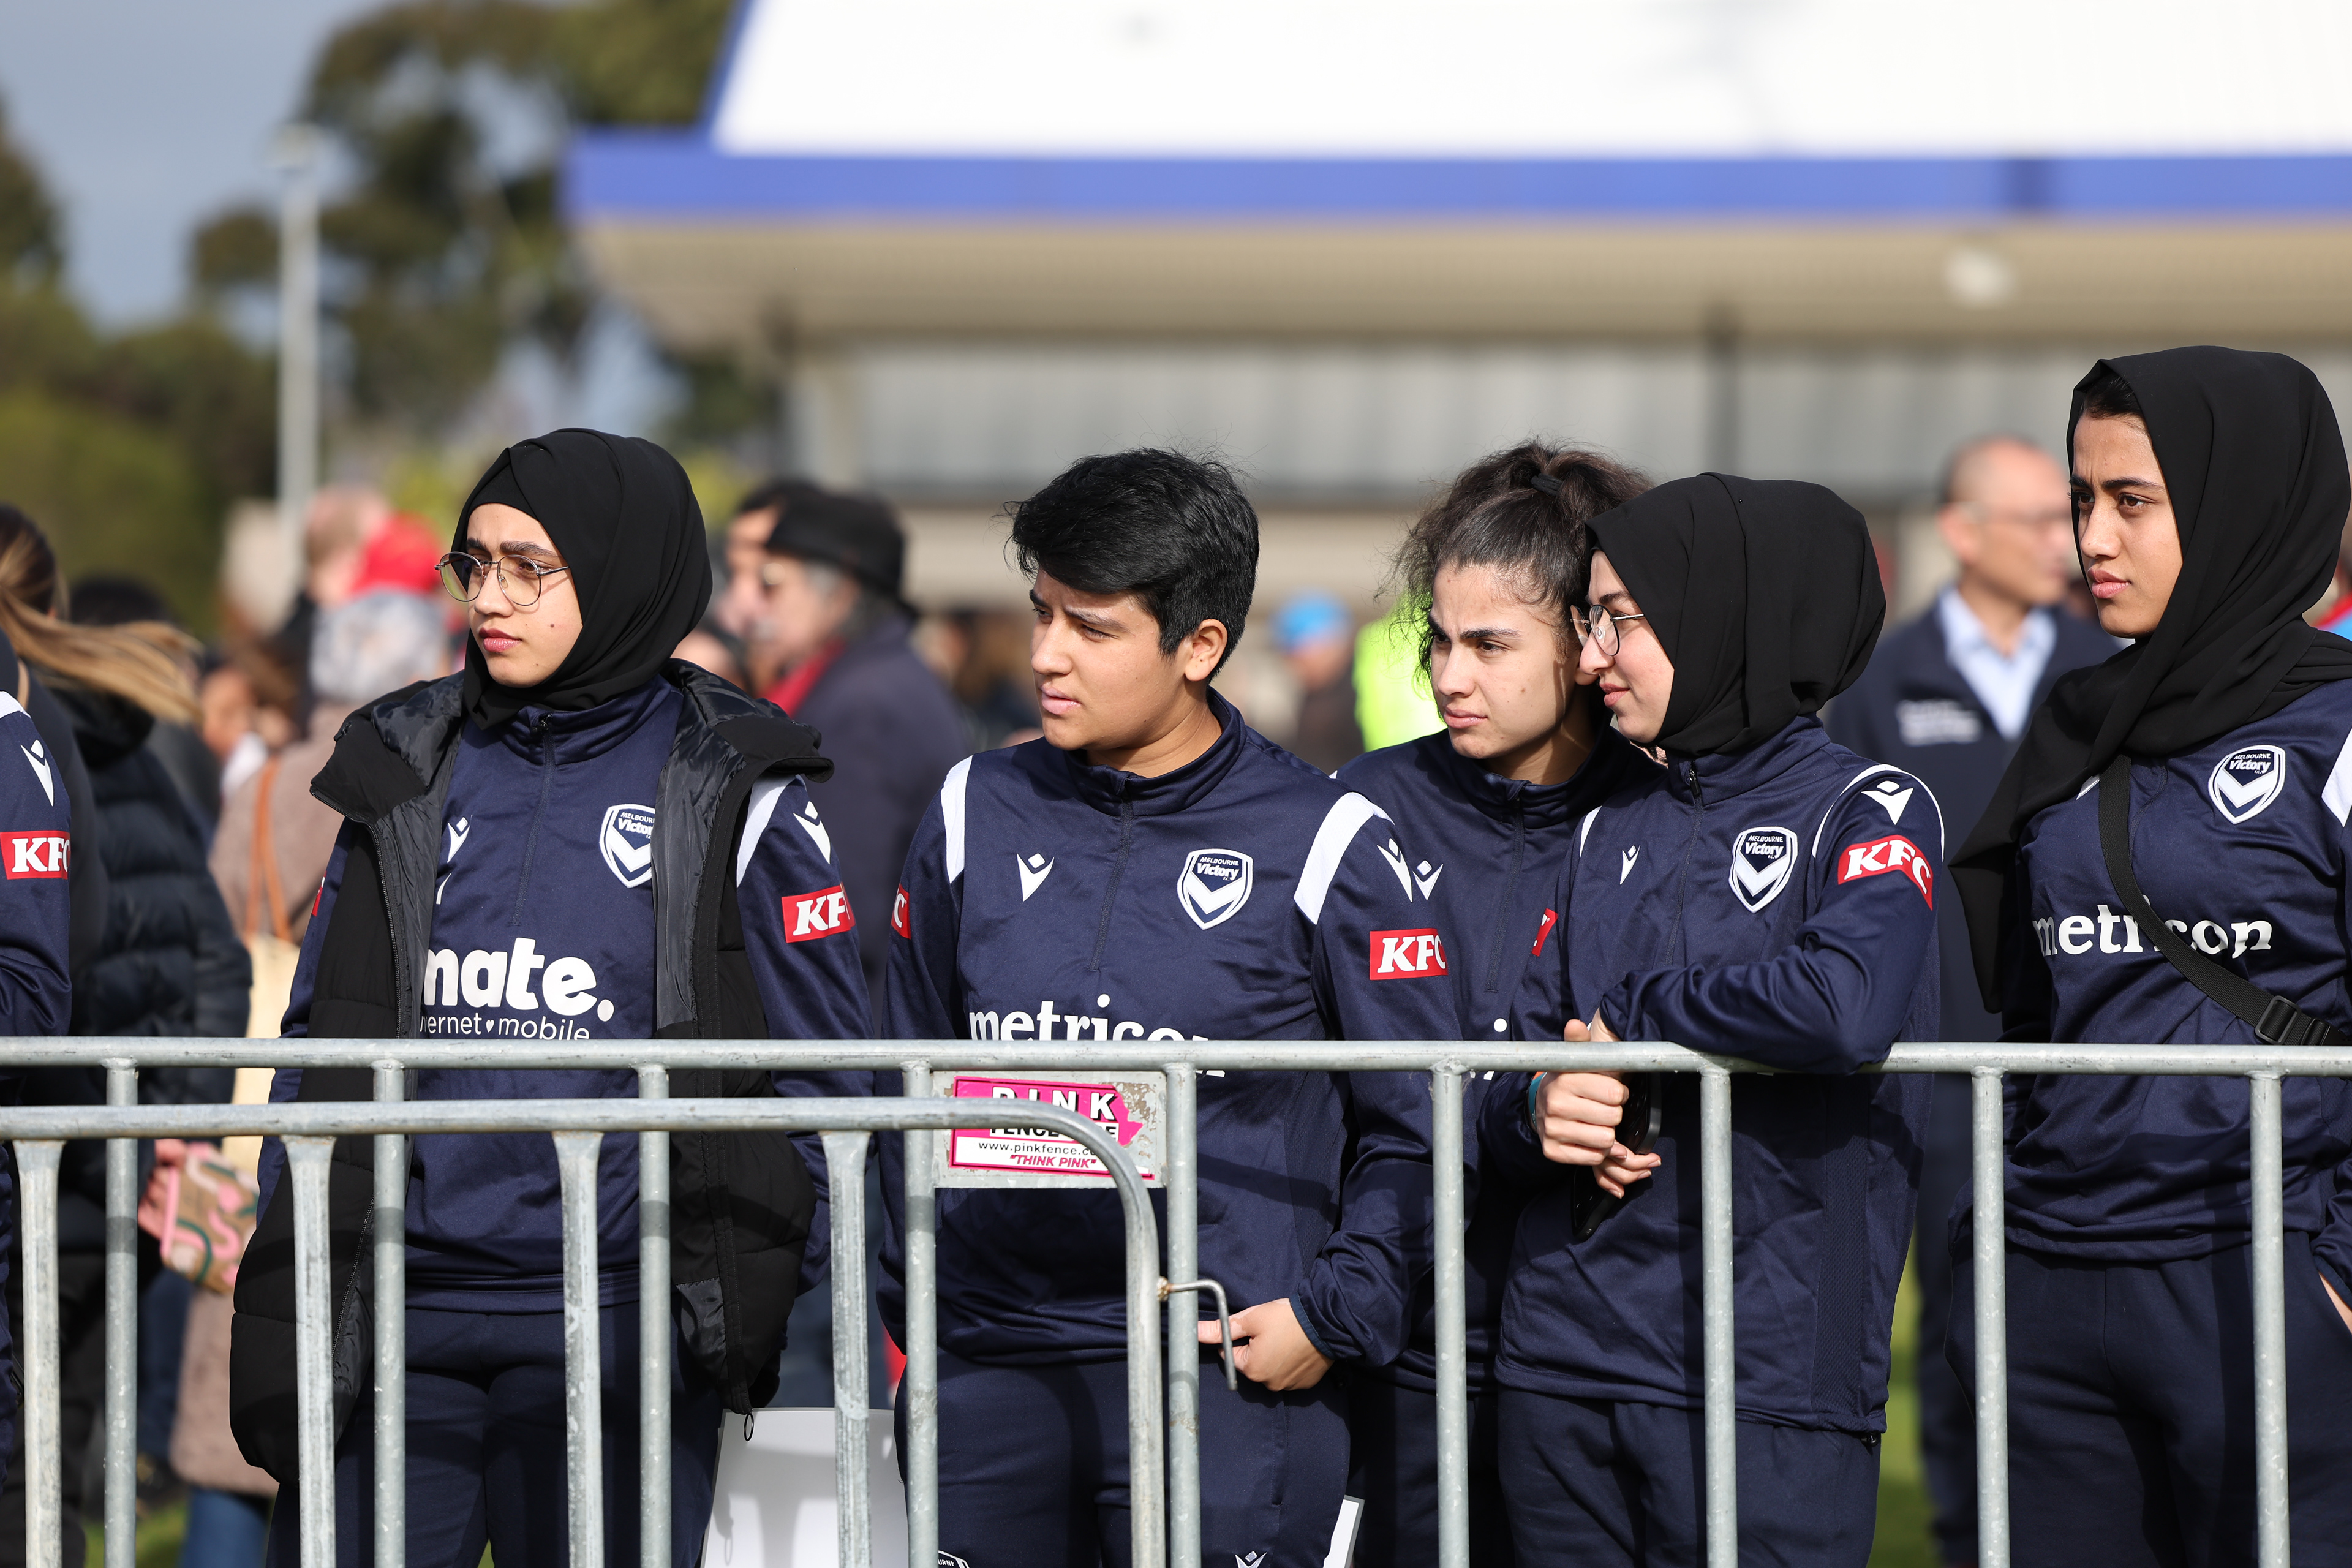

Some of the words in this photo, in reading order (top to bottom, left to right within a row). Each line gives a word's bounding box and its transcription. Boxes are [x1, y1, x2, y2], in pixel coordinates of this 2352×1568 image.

[2230, 760, 2271, 774] Victory
[12, 837, 70, 873] KFC
[1200, 857, 1239, 866] MELBOURNE
[1745, 842, 1784, 859] Victory
[1844, 839, 1930, 894] KFC
[1197, 862, 1239, 881] Victory
[793, 891, 850, 936] KF
[2032, 895, 2272, 959] metron
[1377, 935, 1446, 973] KFC
[499, 1016, 590, 1041] mobile
[969, 993, 1224, 1077] metric
